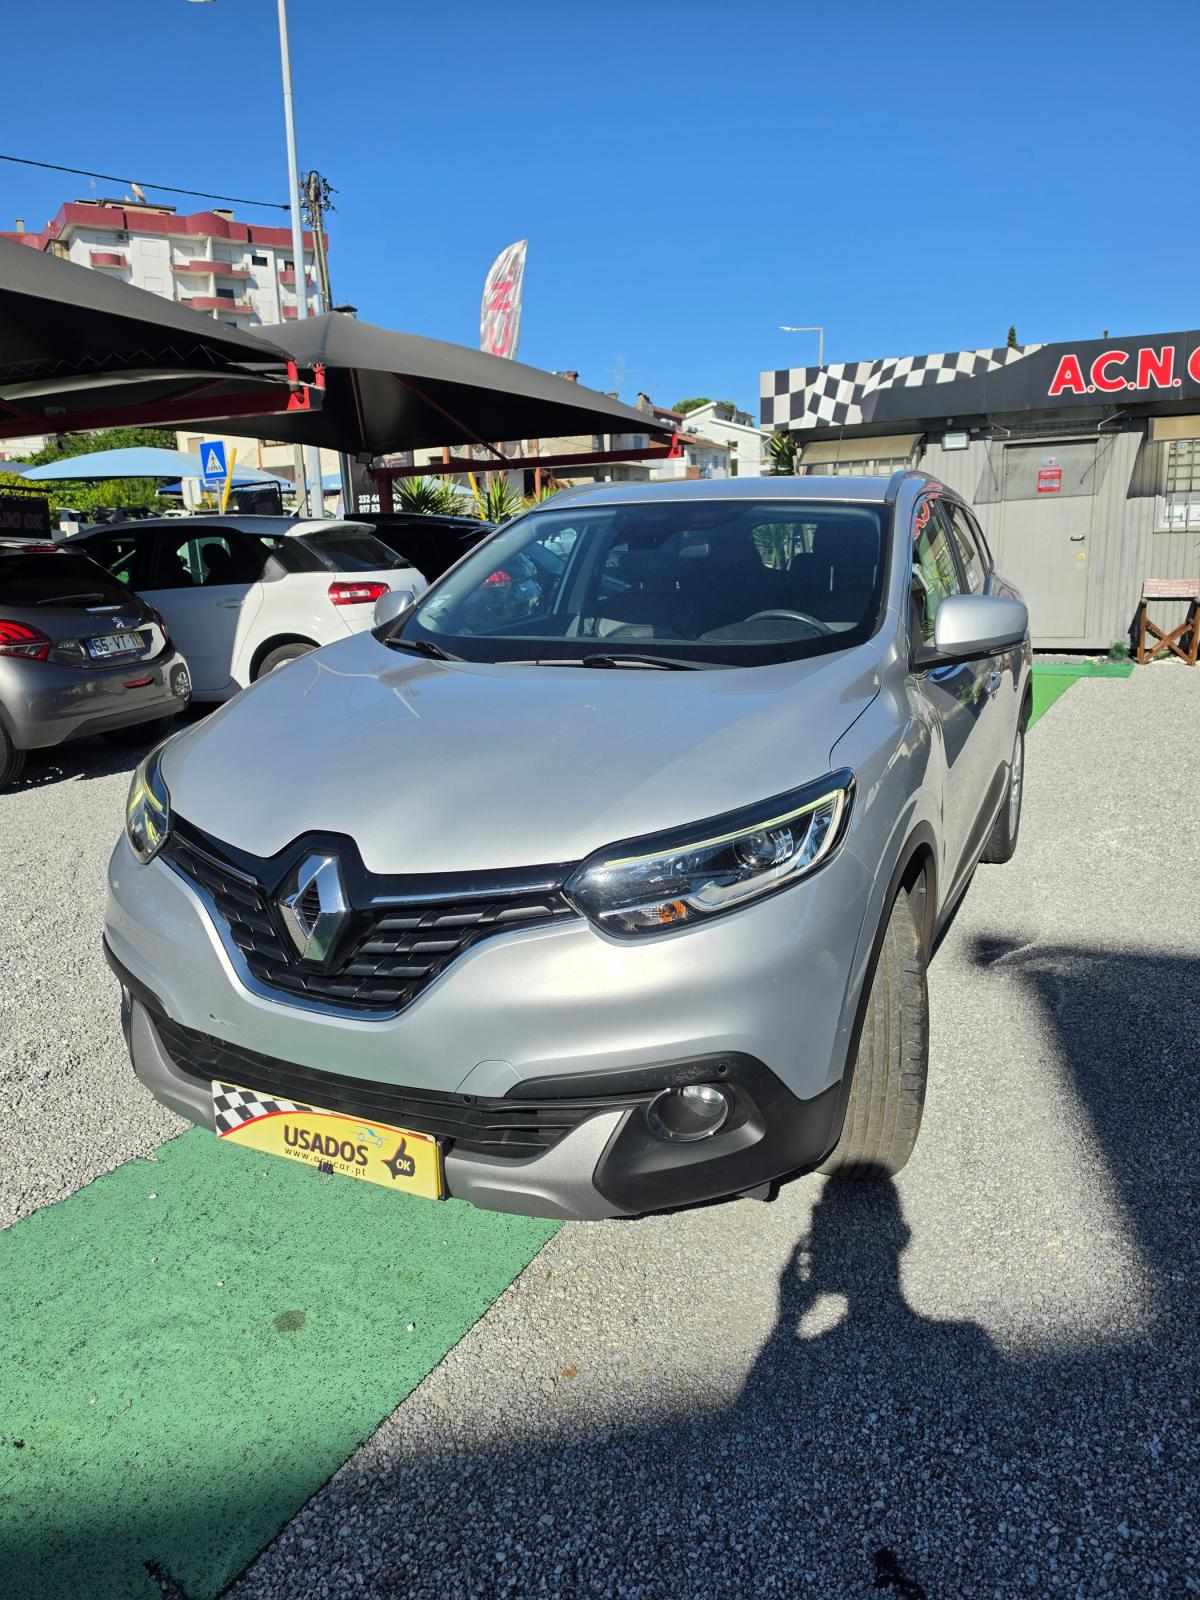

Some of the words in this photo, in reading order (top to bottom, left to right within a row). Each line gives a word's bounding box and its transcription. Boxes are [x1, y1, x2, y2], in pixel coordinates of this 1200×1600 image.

[1048, 346, 1181, 395] A.C.N.
[284, 1124, 369, 1166] USADOS
[396, 1158, 411, 1172] OK
